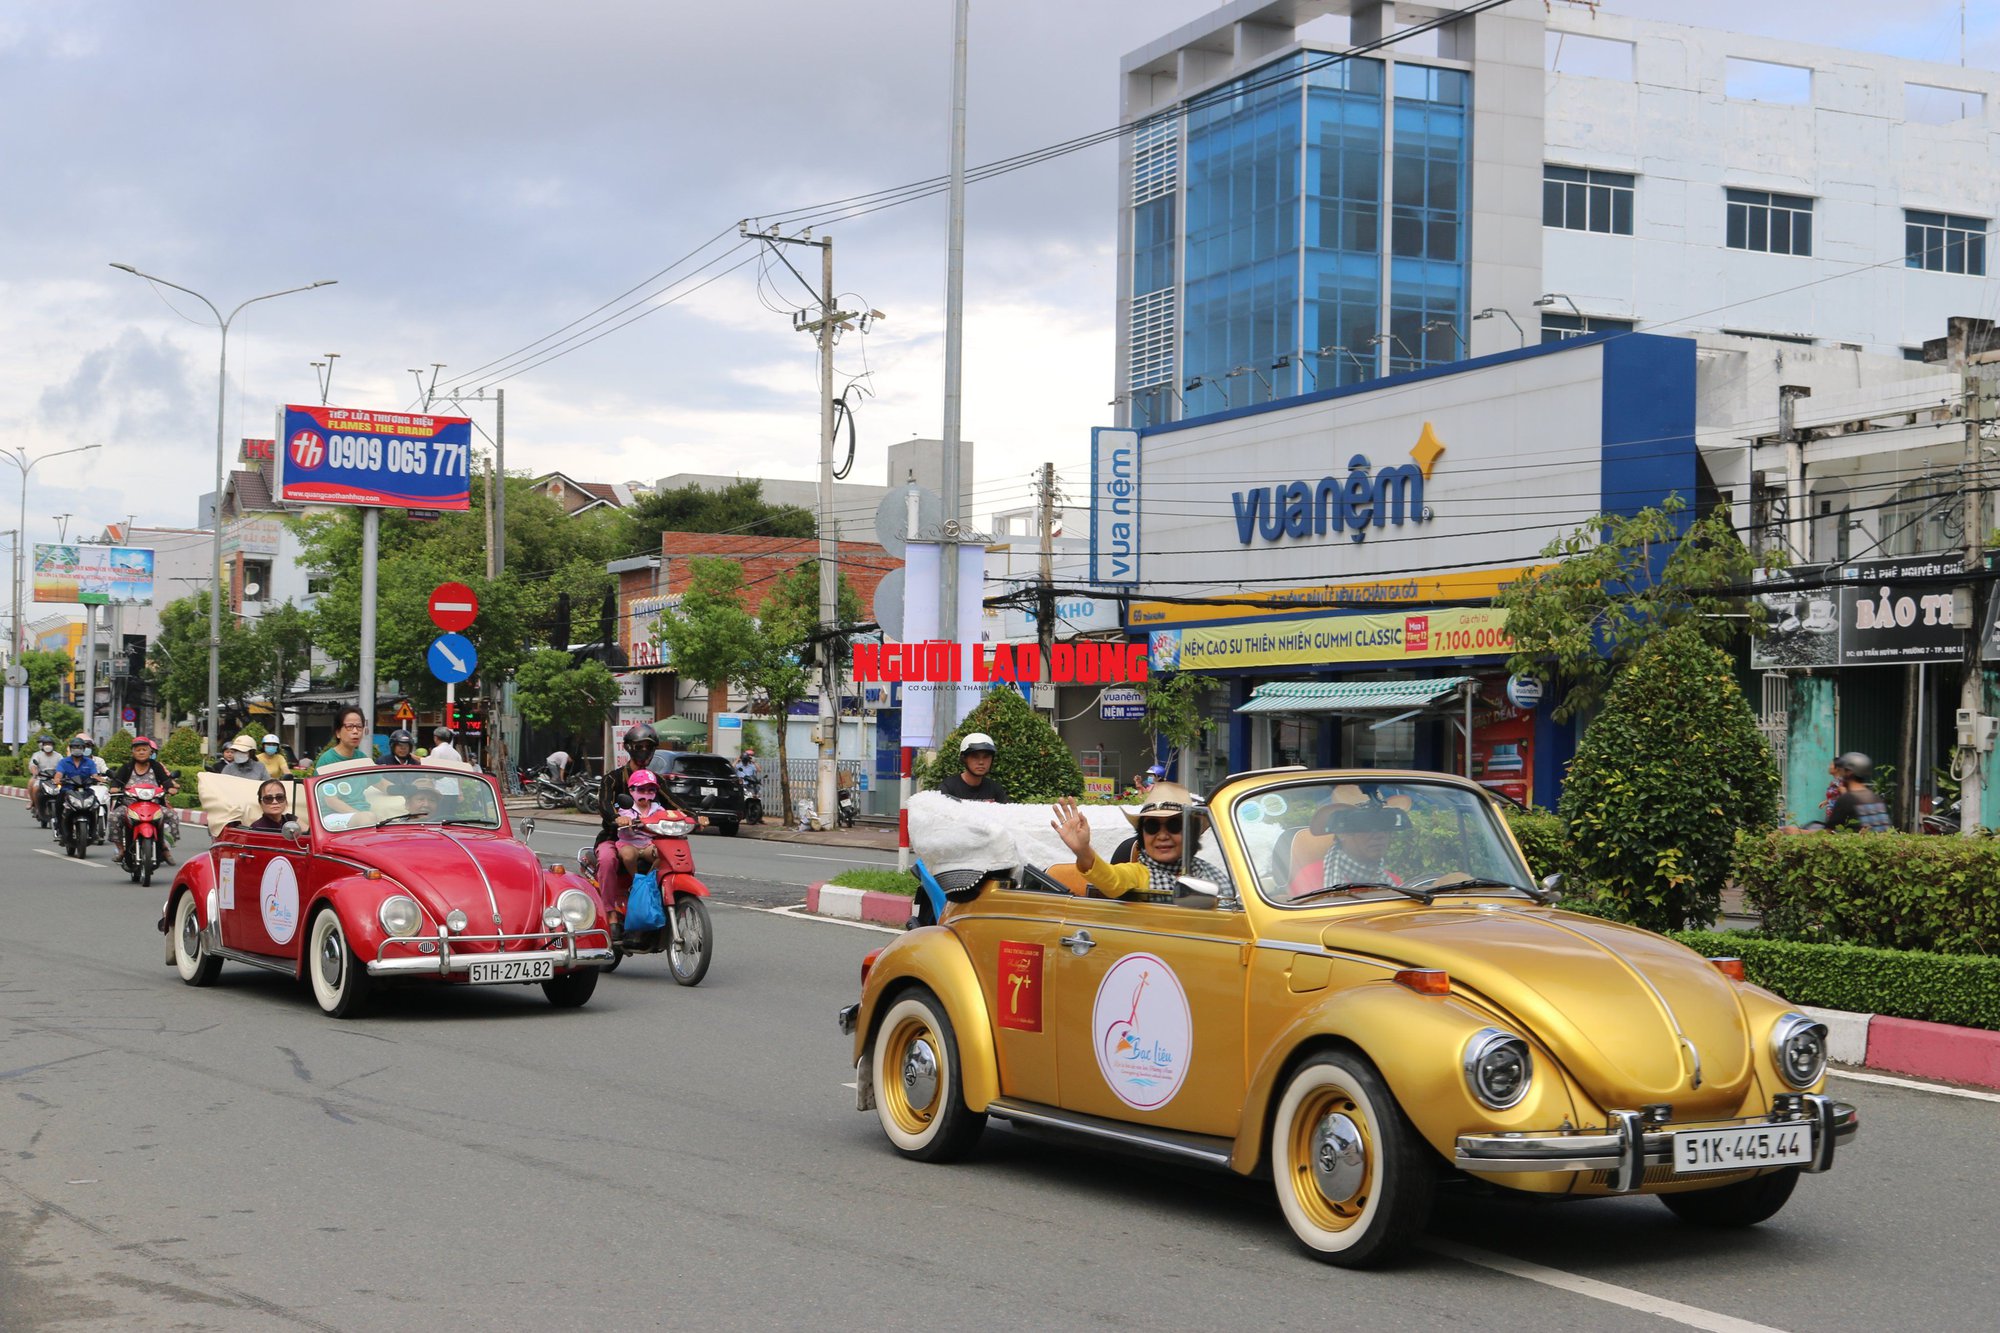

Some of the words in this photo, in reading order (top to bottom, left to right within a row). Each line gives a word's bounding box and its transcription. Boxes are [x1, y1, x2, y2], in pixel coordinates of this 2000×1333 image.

[328, 409, 348, 419] TIẾP
[351, 408, 370, 422] LỬA
[373, 413, 410, 424] THƯƠNG
[413, 416, 434, 427] HIỆU
[328, 420, 371, 431] FLAMES
[375, 424, 394, 433] THE
[397, 425, 433, 437] BRAND
[328, 435, 383, 471] 0909
[387, 439, 427, 475] 065
[433, 442, 467, 477] 771
[287, 489, 380, 502] www.quangcaothanhhuy.com
[1232, 454, 1424, 544] vuanệm
[1863, 567, 1876, 579] CÀ
[1879, 565, 1899, 578] PHÊ
[1901, 563, 1941, 577] NGUYÊN
[1943, 560, 1964, 575] CHẤ
[1388, 585, 1401, 599] GA
[1402, 578, 1418, 599] GỐI
[1056, 601, 1094, 619] KHO
[1856, 586, 1917, 630] BẢO
[1408, 622, 1420, 631] Mua
[1184, 638, 1205, 661] NỆM
[1207, 639, 1227, 655] CAO
[1230, 638, 1243, 654] SU
[1245, 633, 1276, 653] THIÊN
[1278, 631, 1311, 651] NHIÊN
[1314, 631, 1352, 649] GUMMI
[1355, 628, 1402, 646] CLASSIC
[1103, 705, 1125, 719] NỆM
[1103, 783, 1112, 792] 68
[473, 960, 550, 981] 51H-274.82
[1007, 973, 1032, 1015] 7+
[1686, 1132, 1799, 1164] 51K-445.44
